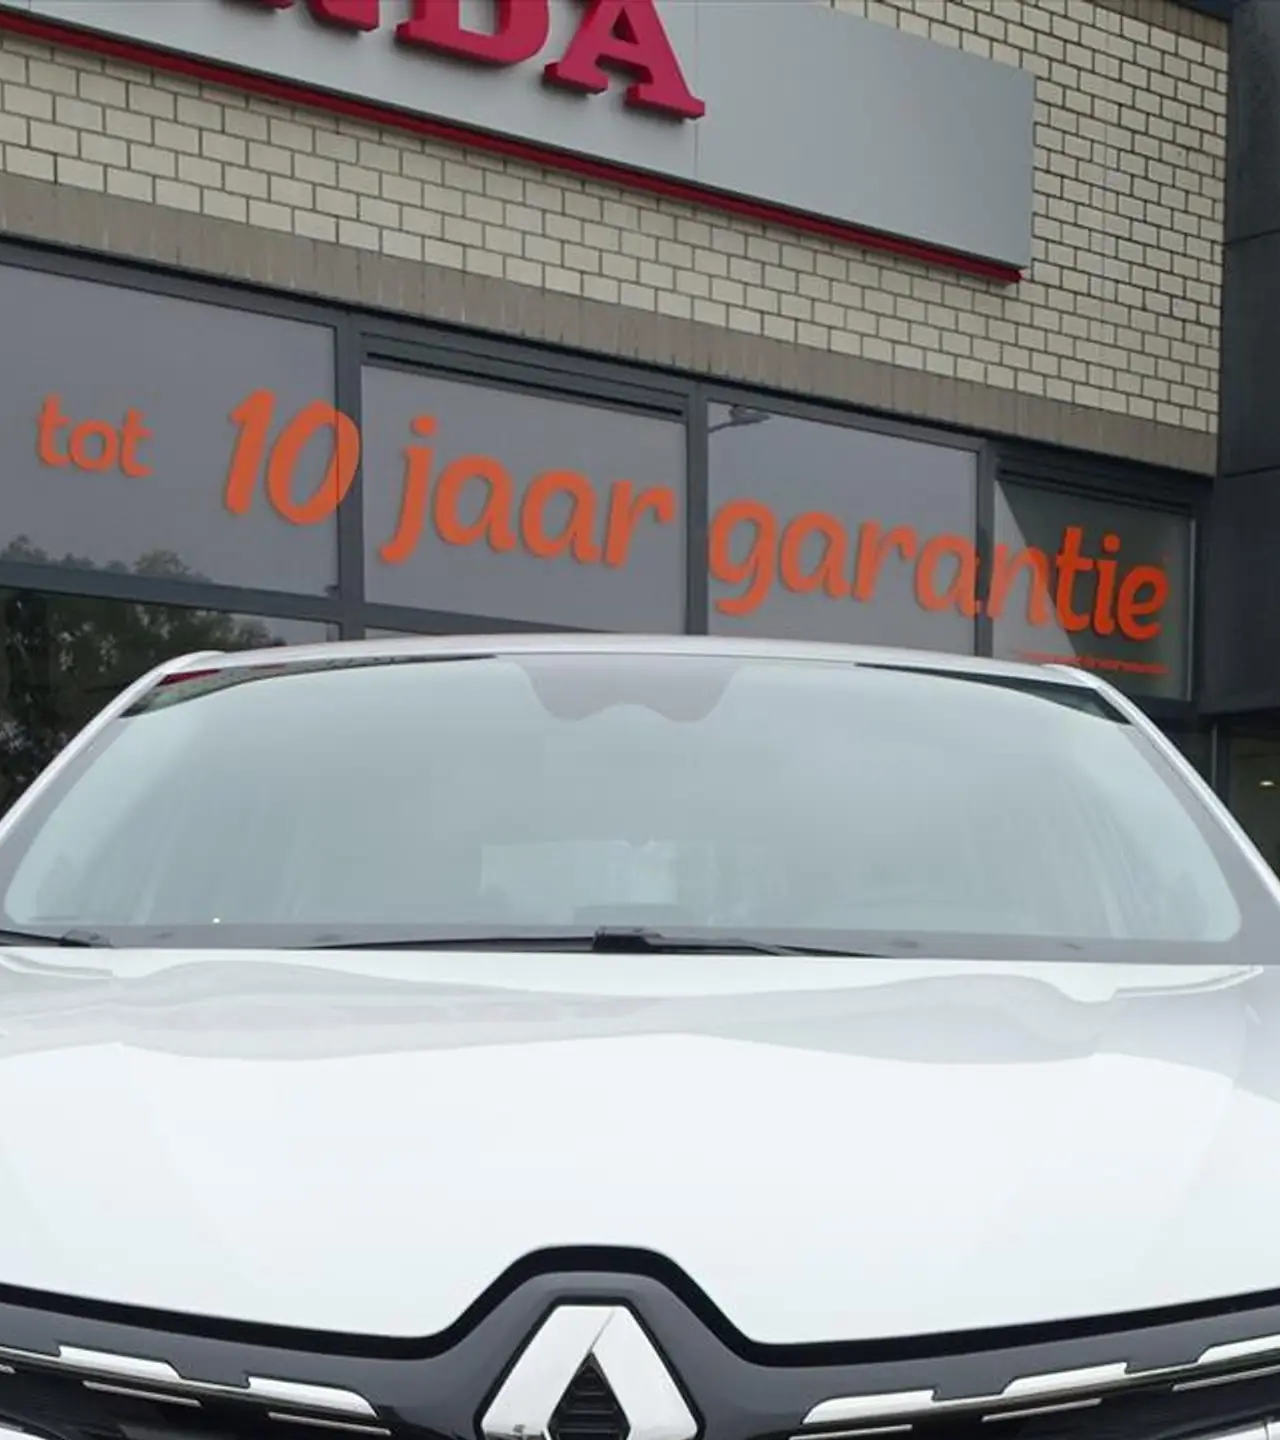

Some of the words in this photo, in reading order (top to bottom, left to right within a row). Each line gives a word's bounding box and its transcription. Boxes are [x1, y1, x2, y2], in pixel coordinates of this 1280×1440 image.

[38, 395, 151, 477] tot
[224, 390, 360, 525] 10
[380, 415, 675, 567] jaar
[707, 500, 1169, 641] garantie
